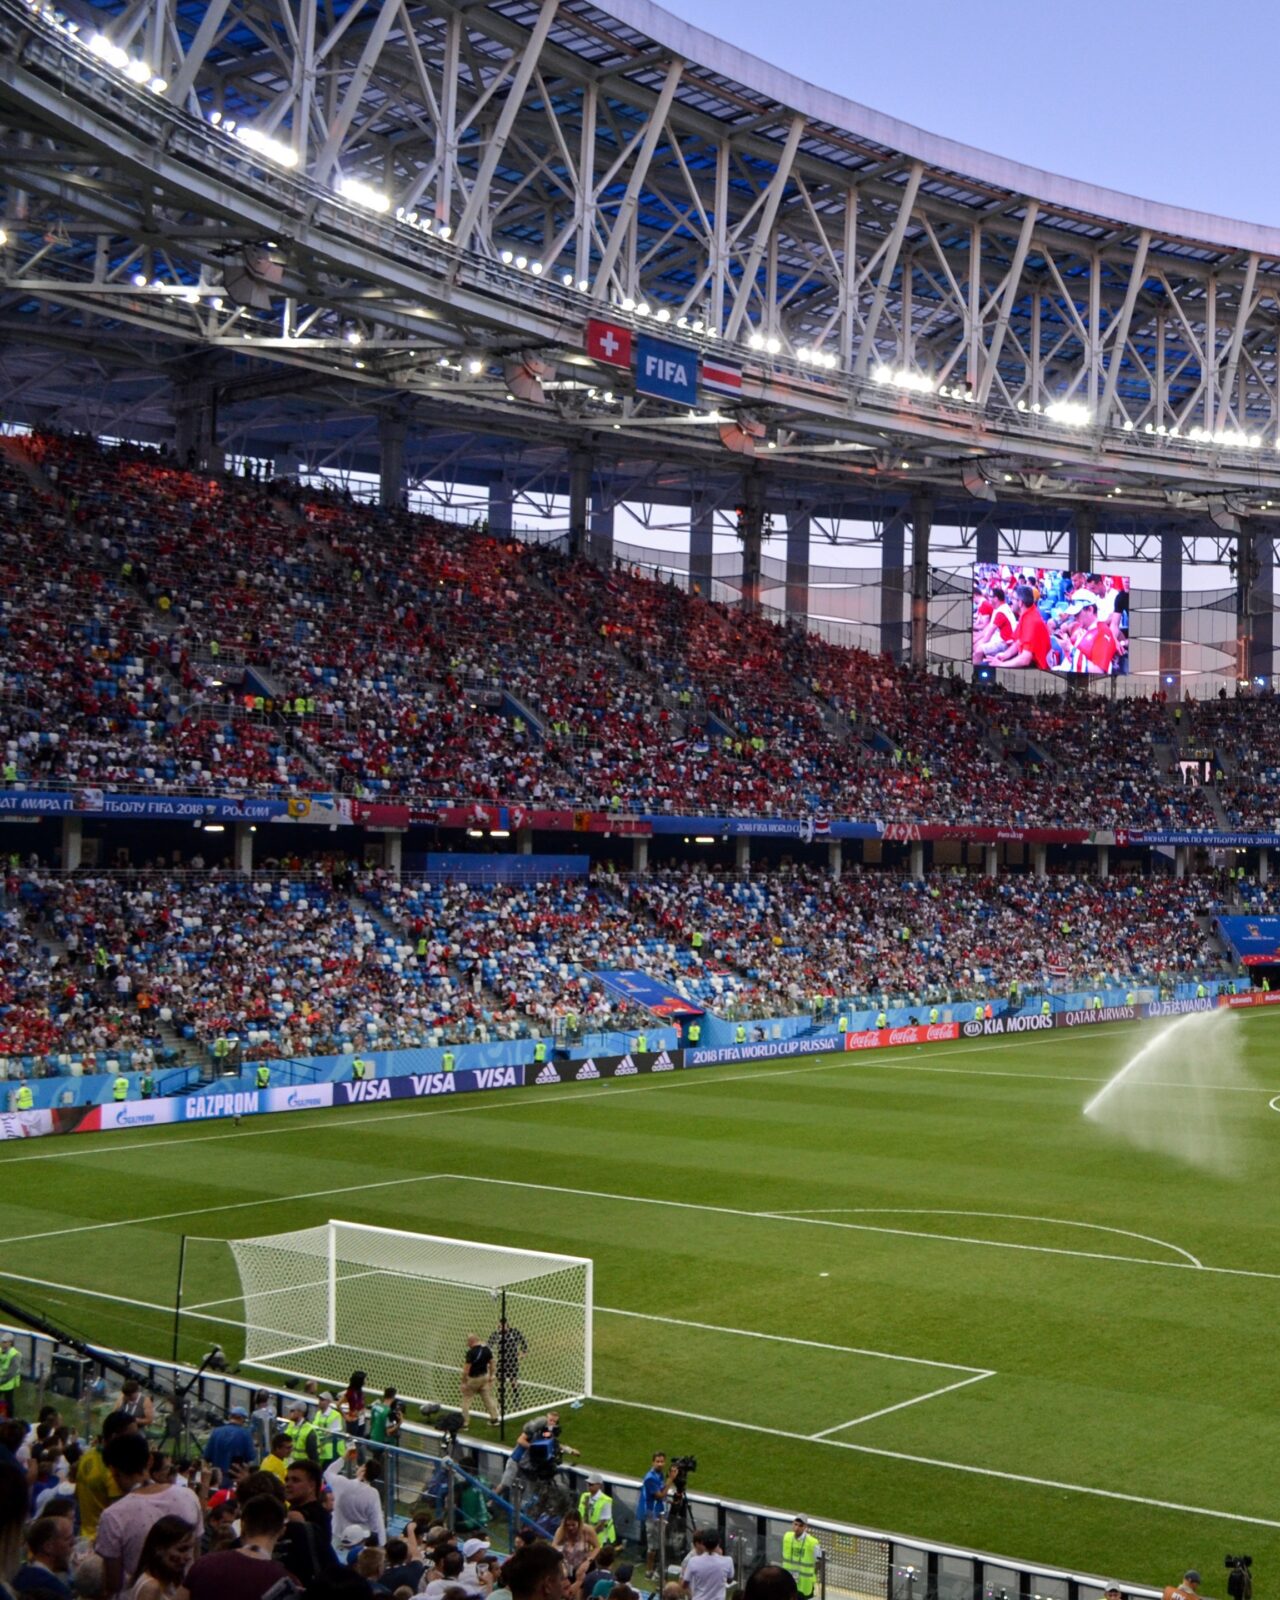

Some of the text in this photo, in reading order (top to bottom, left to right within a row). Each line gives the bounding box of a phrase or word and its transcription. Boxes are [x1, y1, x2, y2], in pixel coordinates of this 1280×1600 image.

[646, 355, 688, 387] FIFA
[21, 798, 61, 810] МИРА
[103, 800, 145, 813] ТБОЛУ
[148, 802, 174, 814] FIFA
[176, 803, 204, 815] 2018
[222, 805, 269, 817] РОССИИ
[736, 823, 752, 832] 2018
[753, 823, 768, 832] FIFA
[768, 823, 792, 833] WORLD
[1181, 997, 1212, 1012] WANDA
[984, 1014, 1053, 1035] KIA MOTORS
[1066, 1004, 1134, 1026] QATAR AIRWAYS
[966, 1024, 981, 1033] KIA
[693, 1049, 717, 1063] 2018
[718, 1047, 740, 1061] FIFA
[741, 1043, 777, 1058] WORLD
[778, 1041, 799, 1054] CUP
[576, 1070, 600, 1080] adidas
[614, 1066, 638, 1076] adidas
[651, 1063, 674, 1072] adidas
[410, 1072, 456, 1095] VISA
[473, 1067, 516, 1089] VISA
[535, 1074, 561, 1085] adidas
[342, 1078, 391, 1102] VISA
[185, 1092, 259, 1118] GAZPROM
